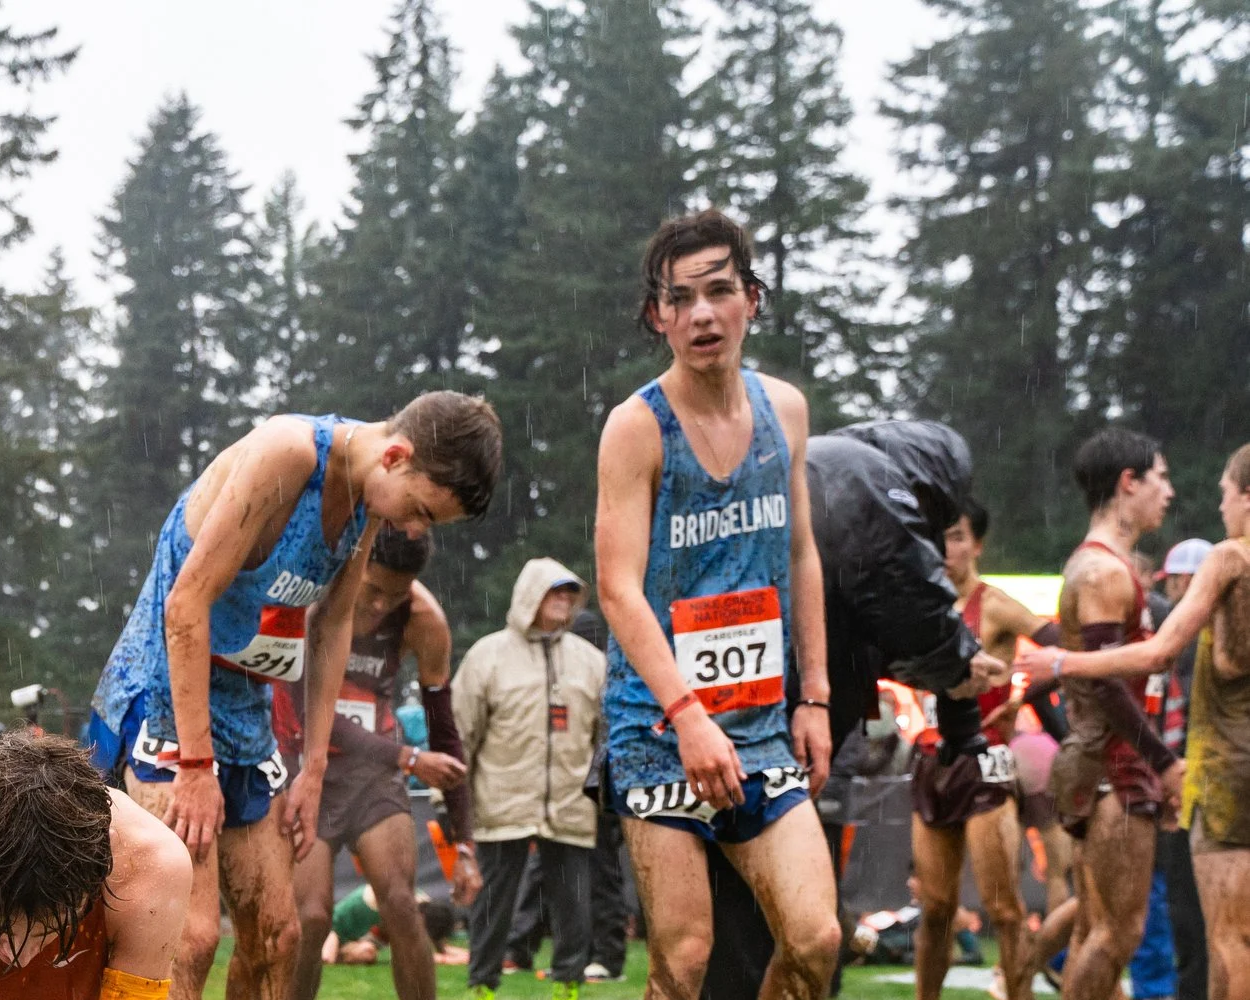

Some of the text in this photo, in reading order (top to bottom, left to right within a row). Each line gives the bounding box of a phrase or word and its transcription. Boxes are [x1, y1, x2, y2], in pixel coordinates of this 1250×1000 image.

[670, 494, 787, 549] BRIDGELAND
[694, 605, 766, 623] NATIONALS
[704, 627, 757, 643] CARLISLE
[239, 652, 296, 677] 311
[695, 642, 767, 683] 307
